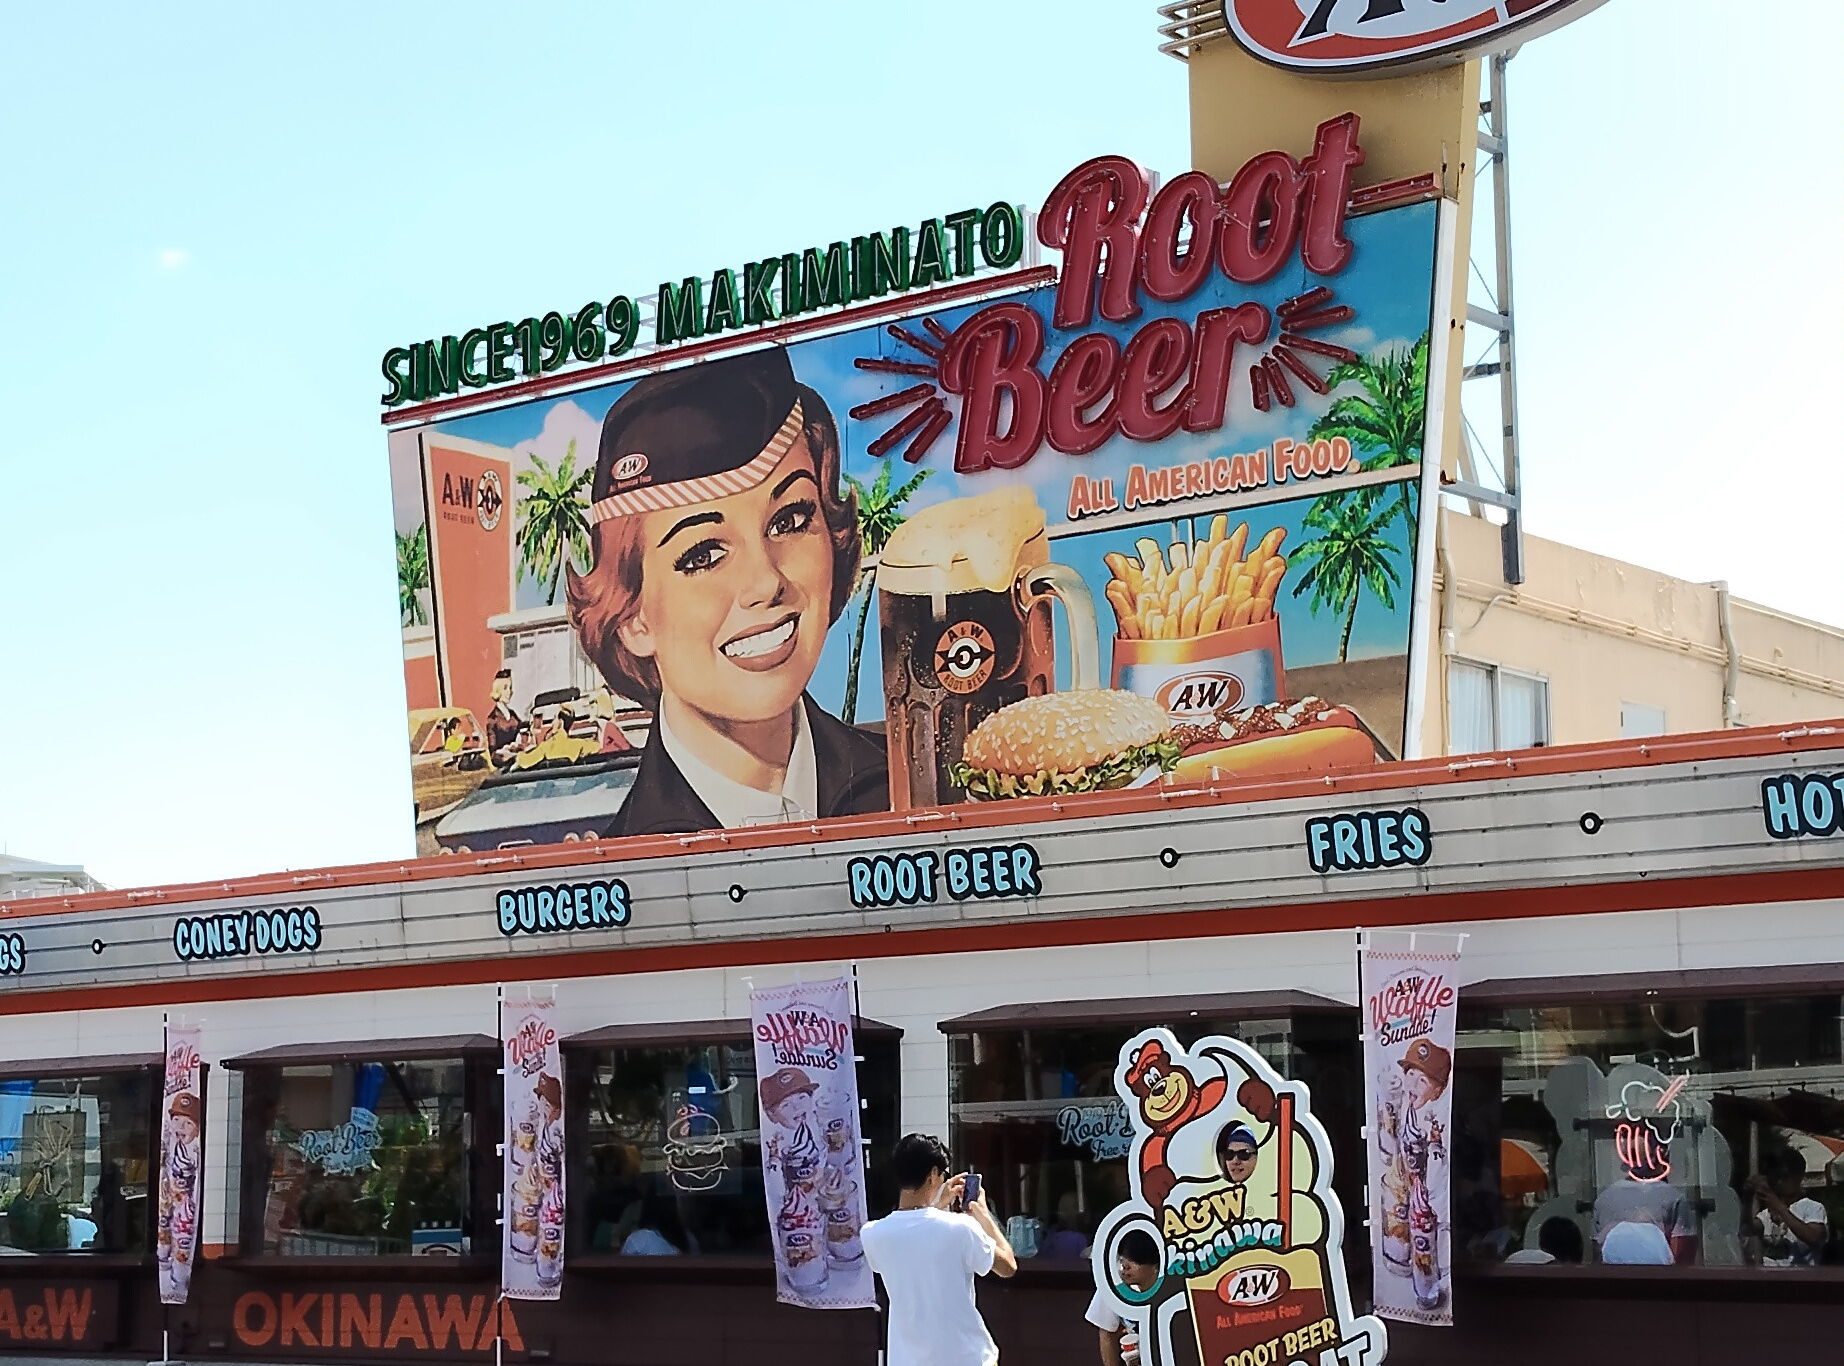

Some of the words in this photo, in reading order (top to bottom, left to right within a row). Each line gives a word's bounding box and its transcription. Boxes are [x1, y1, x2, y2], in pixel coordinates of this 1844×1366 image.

[1037, 111, 1365, 329] Root
[656, 201, 1024, 346] MAKIMINATO
[938, 302, 1270, 474] Beer
[942, 672, 965, 692] ROOT
[966, 668, 988, 691] BEER
[1311, 814, 1426, 868] FRIES
[851, 856, 934, 904] ROOT
[948, 848, 1036, 894] BEER
[176, 914, 248, 957] CONEY
[256, 910, 318, 950] DOGS
[500, 884, 628, 933] BURGERS
[1370, 975, 1454, 1030] Waffle
[1058, 1102, 1116, 1144] Root
[1163, 1187, 1244, 1238] A&W
[232, 1291, 526, 1352] OKINAWA
[1282, 1317, 1338, 1357] BEER
